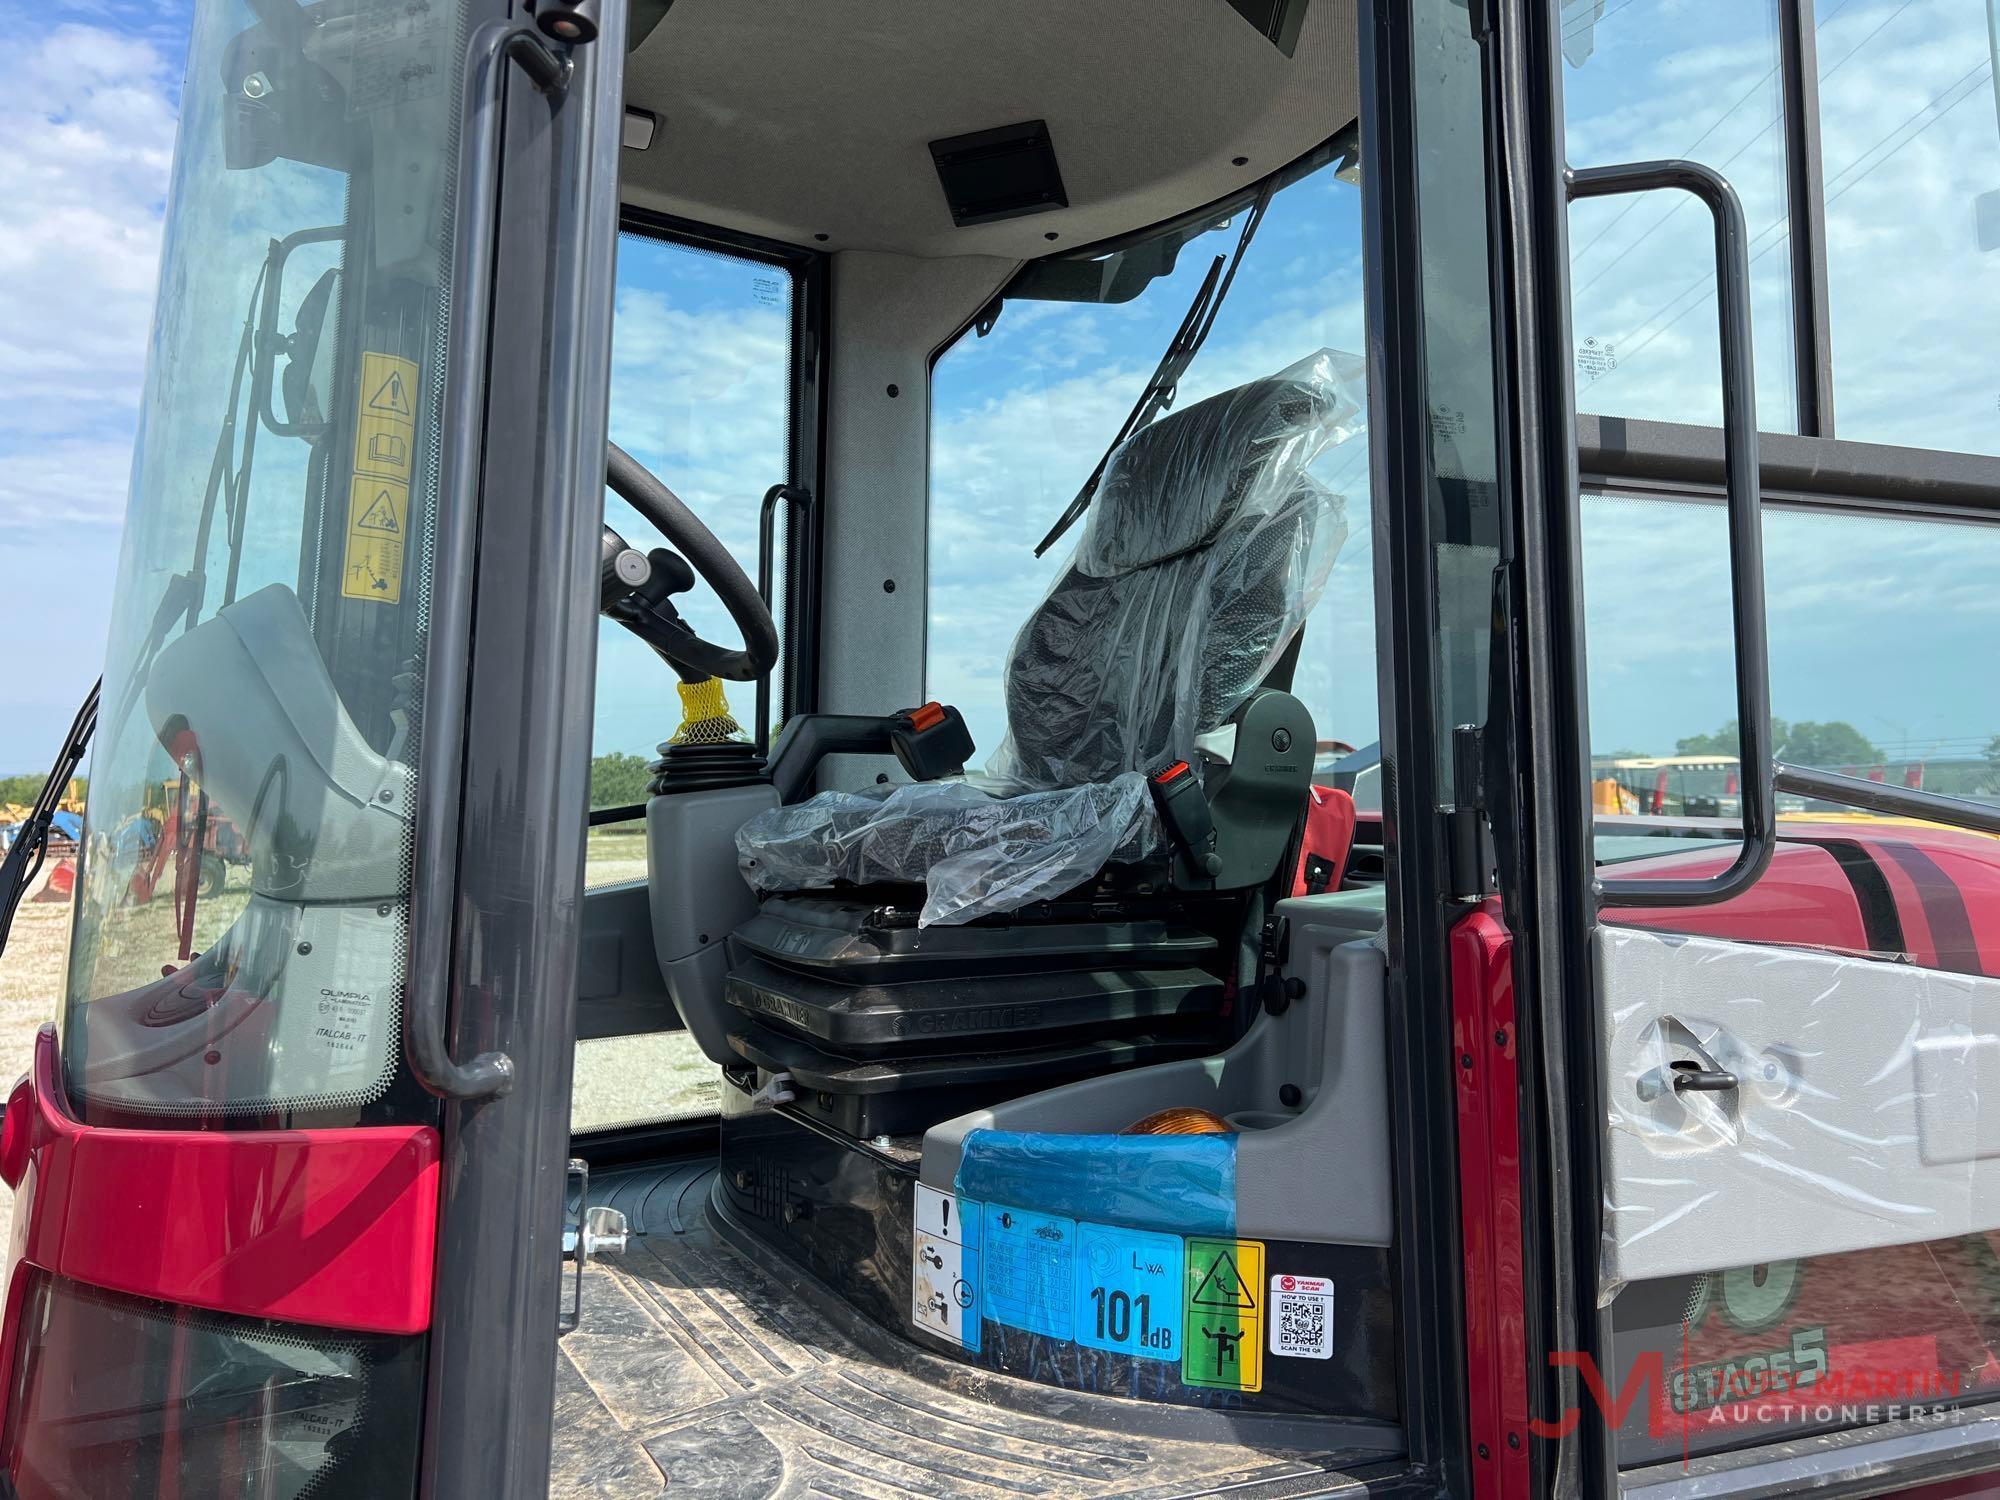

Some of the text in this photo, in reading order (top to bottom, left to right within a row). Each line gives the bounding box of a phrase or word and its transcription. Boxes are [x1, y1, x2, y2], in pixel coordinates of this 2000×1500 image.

[321, 988, 371, 1002] OLIMPIA
[917, 1006, 1042, 1034] GRAMMER
[316, 1028, 351, 1040] ITALCAB
